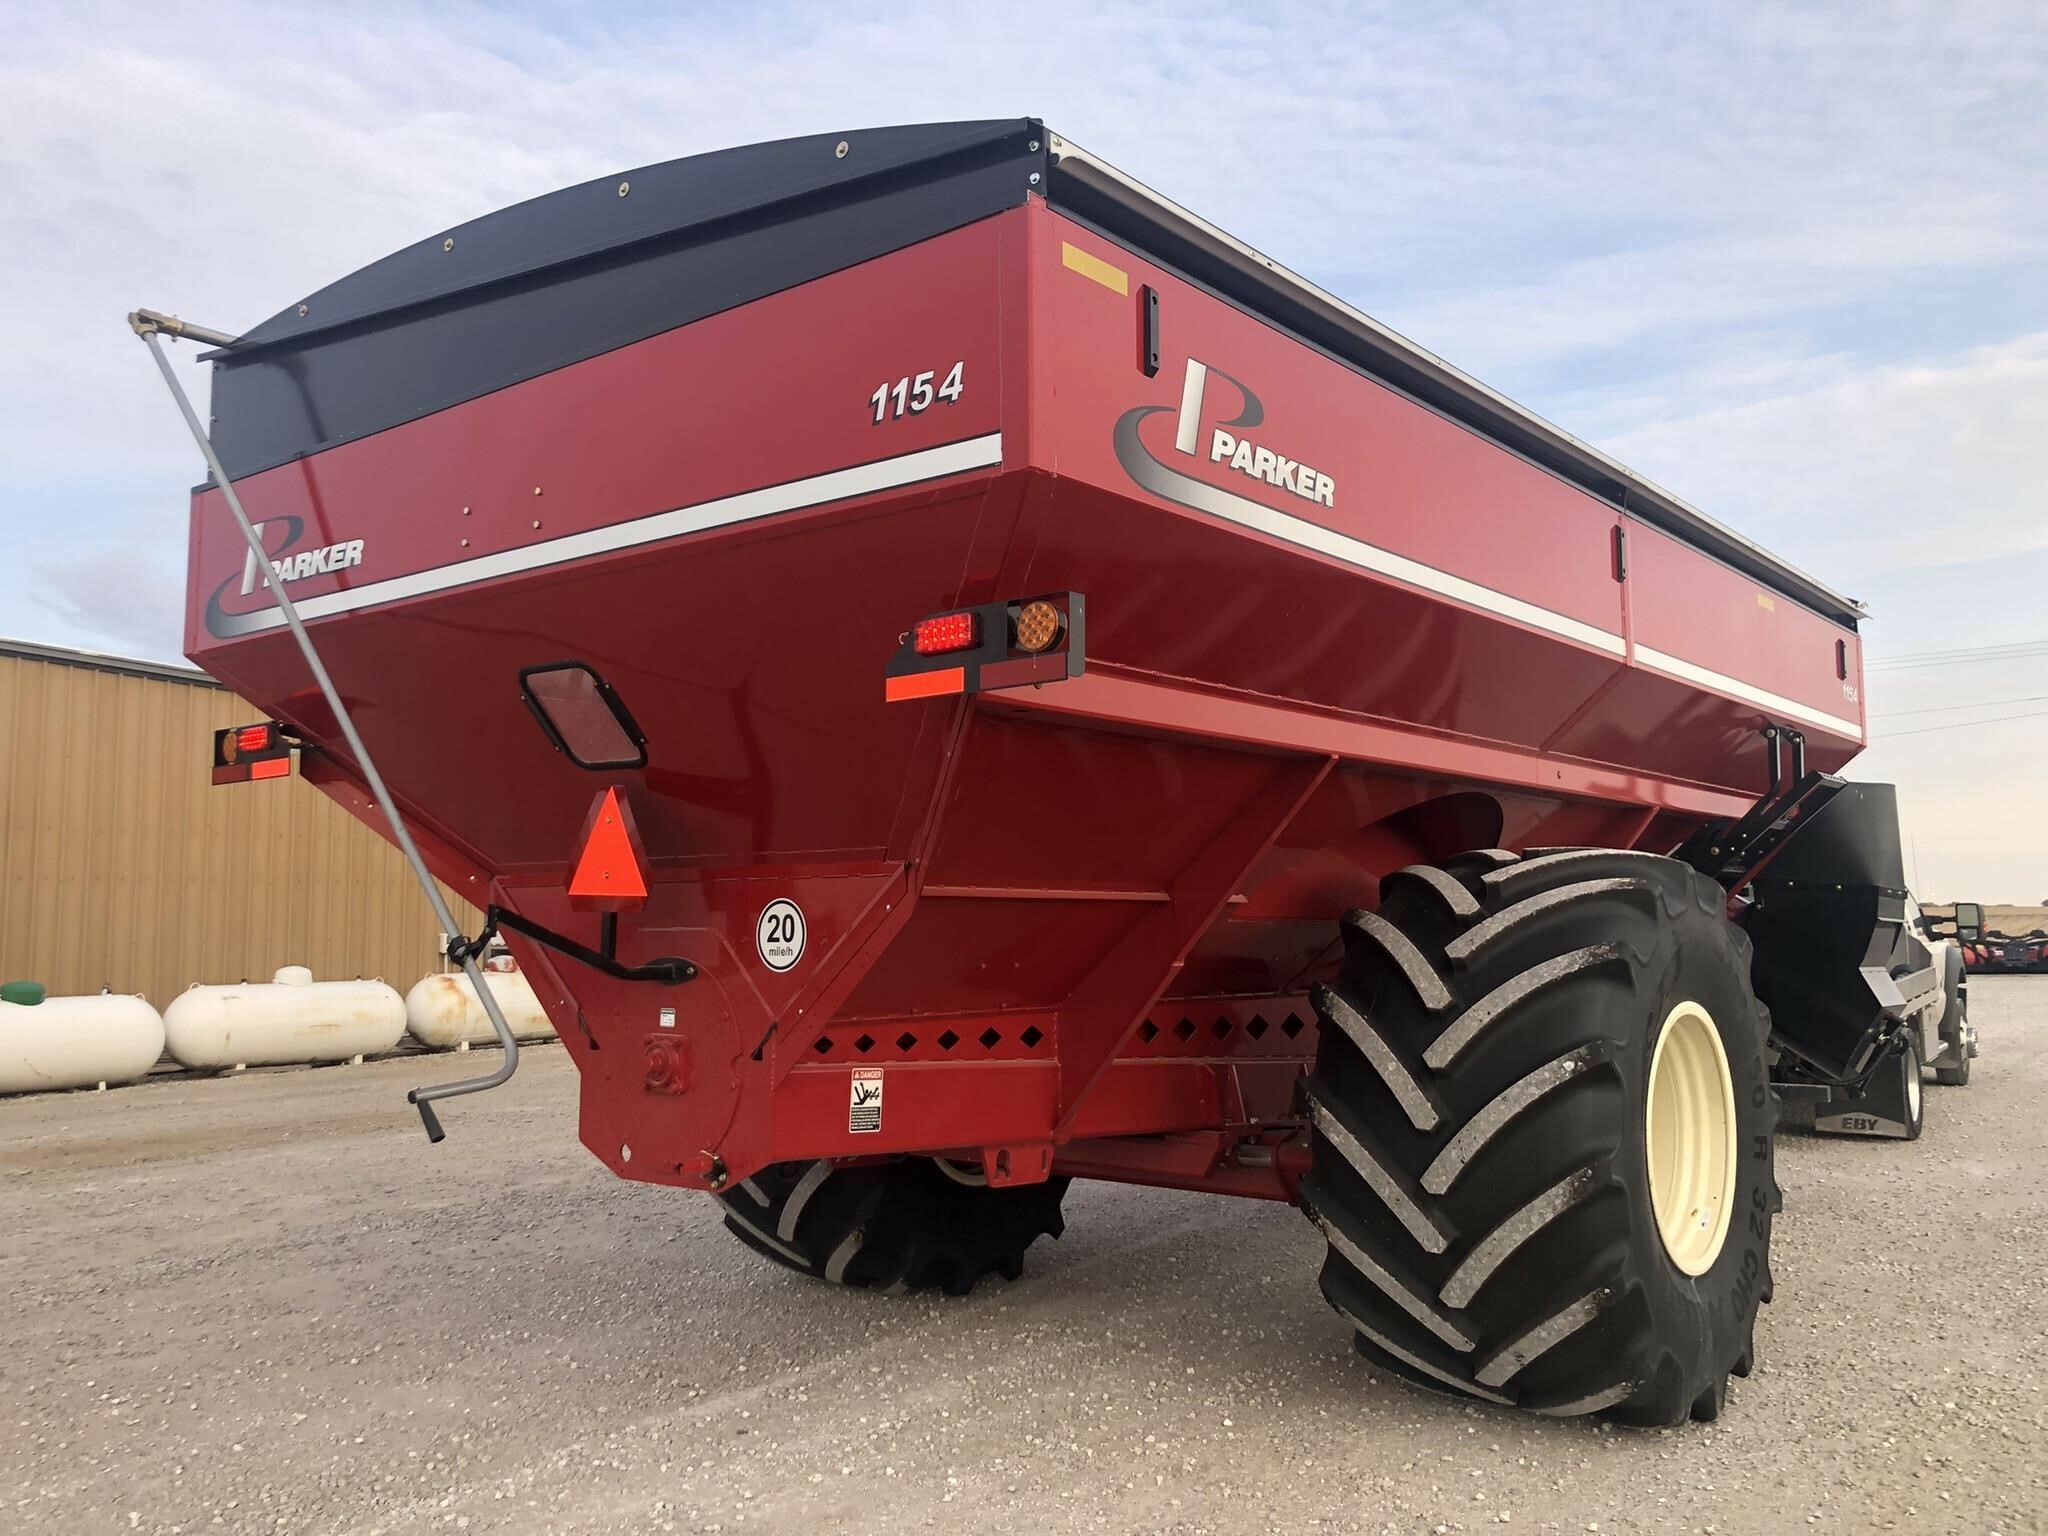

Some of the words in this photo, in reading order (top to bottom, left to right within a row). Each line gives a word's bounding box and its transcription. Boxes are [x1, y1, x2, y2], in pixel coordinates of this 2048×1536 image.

[869, 361, 964, 426] 1154
[1210, 427, 1336, 508] PARKER
[263, 538, 365, 589] PARKER
[767, 914, 795, 943] 20
[768, 947, 793, 957] mile/h
[860, 1071, 881, 1079] DANGER
[1841, 1117, 1878, 1130] EBY
[1754, 1135, 1768, 1161] R
[1750, 1186, 1767, 1240] 32
